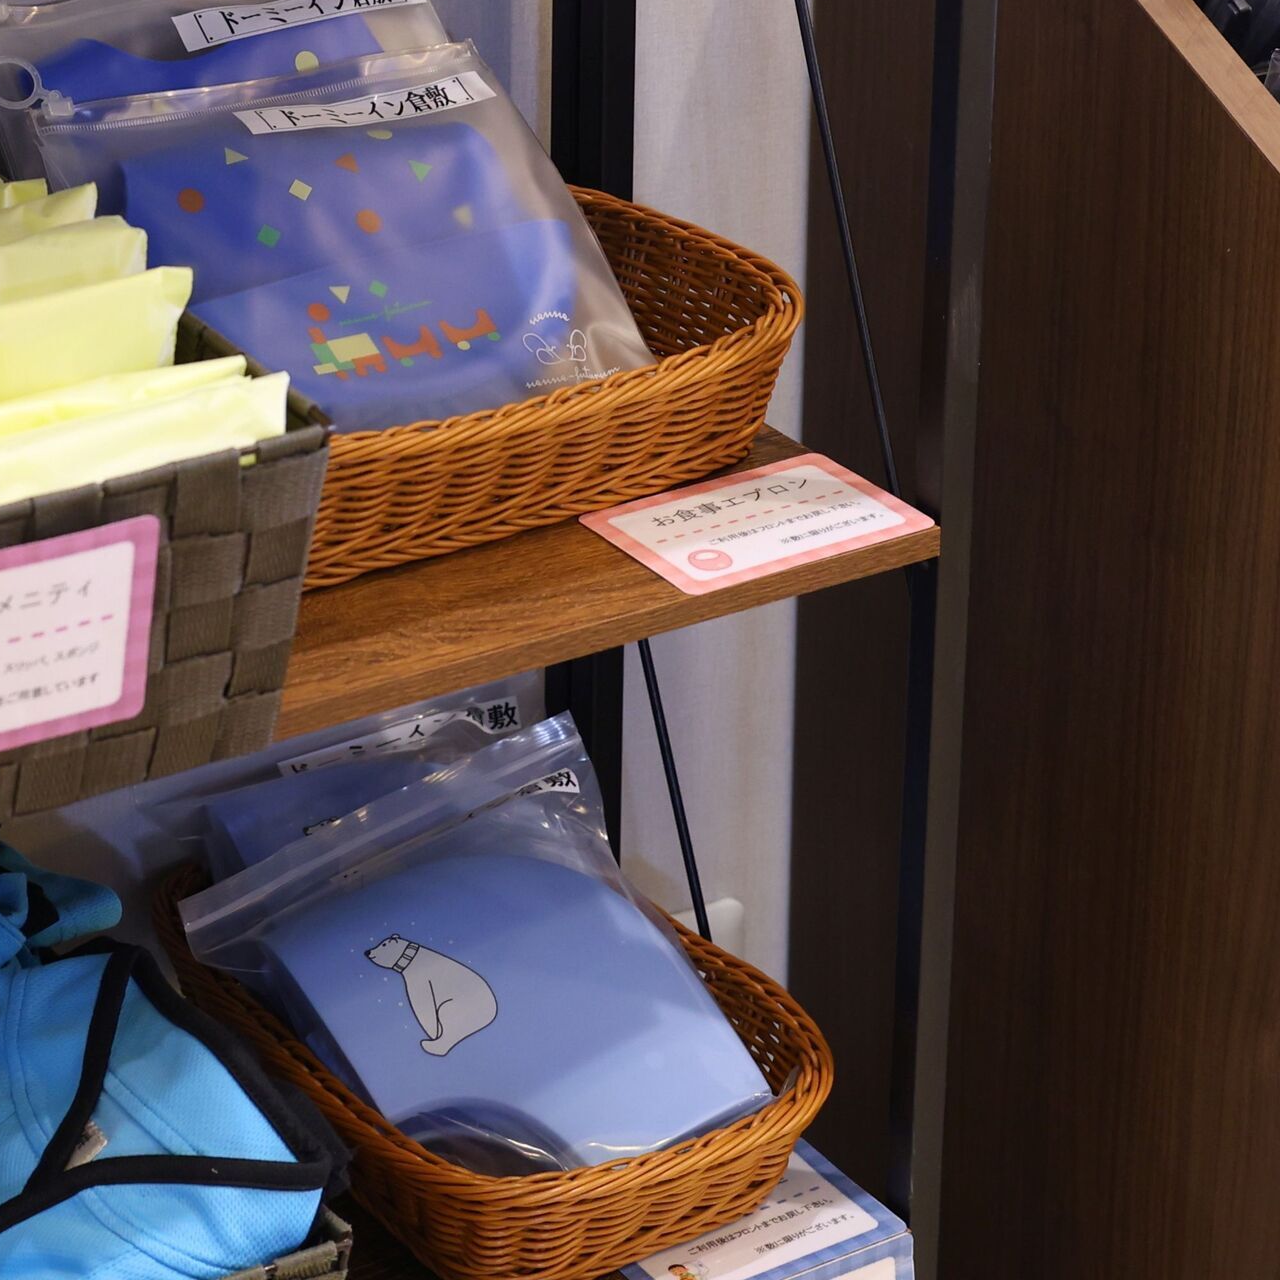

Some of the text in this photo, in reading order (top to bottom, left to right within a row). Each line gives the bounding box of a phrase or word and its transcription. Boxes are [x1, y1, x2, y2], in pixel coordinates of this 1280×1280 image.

[280, 84, 457, 125] ドーミーイン倉敷
[651, 477, 808, 529] お食事エプロン
[687, 1198, 834, 1257] ご利用後はフロントまでお戻し下さい。
